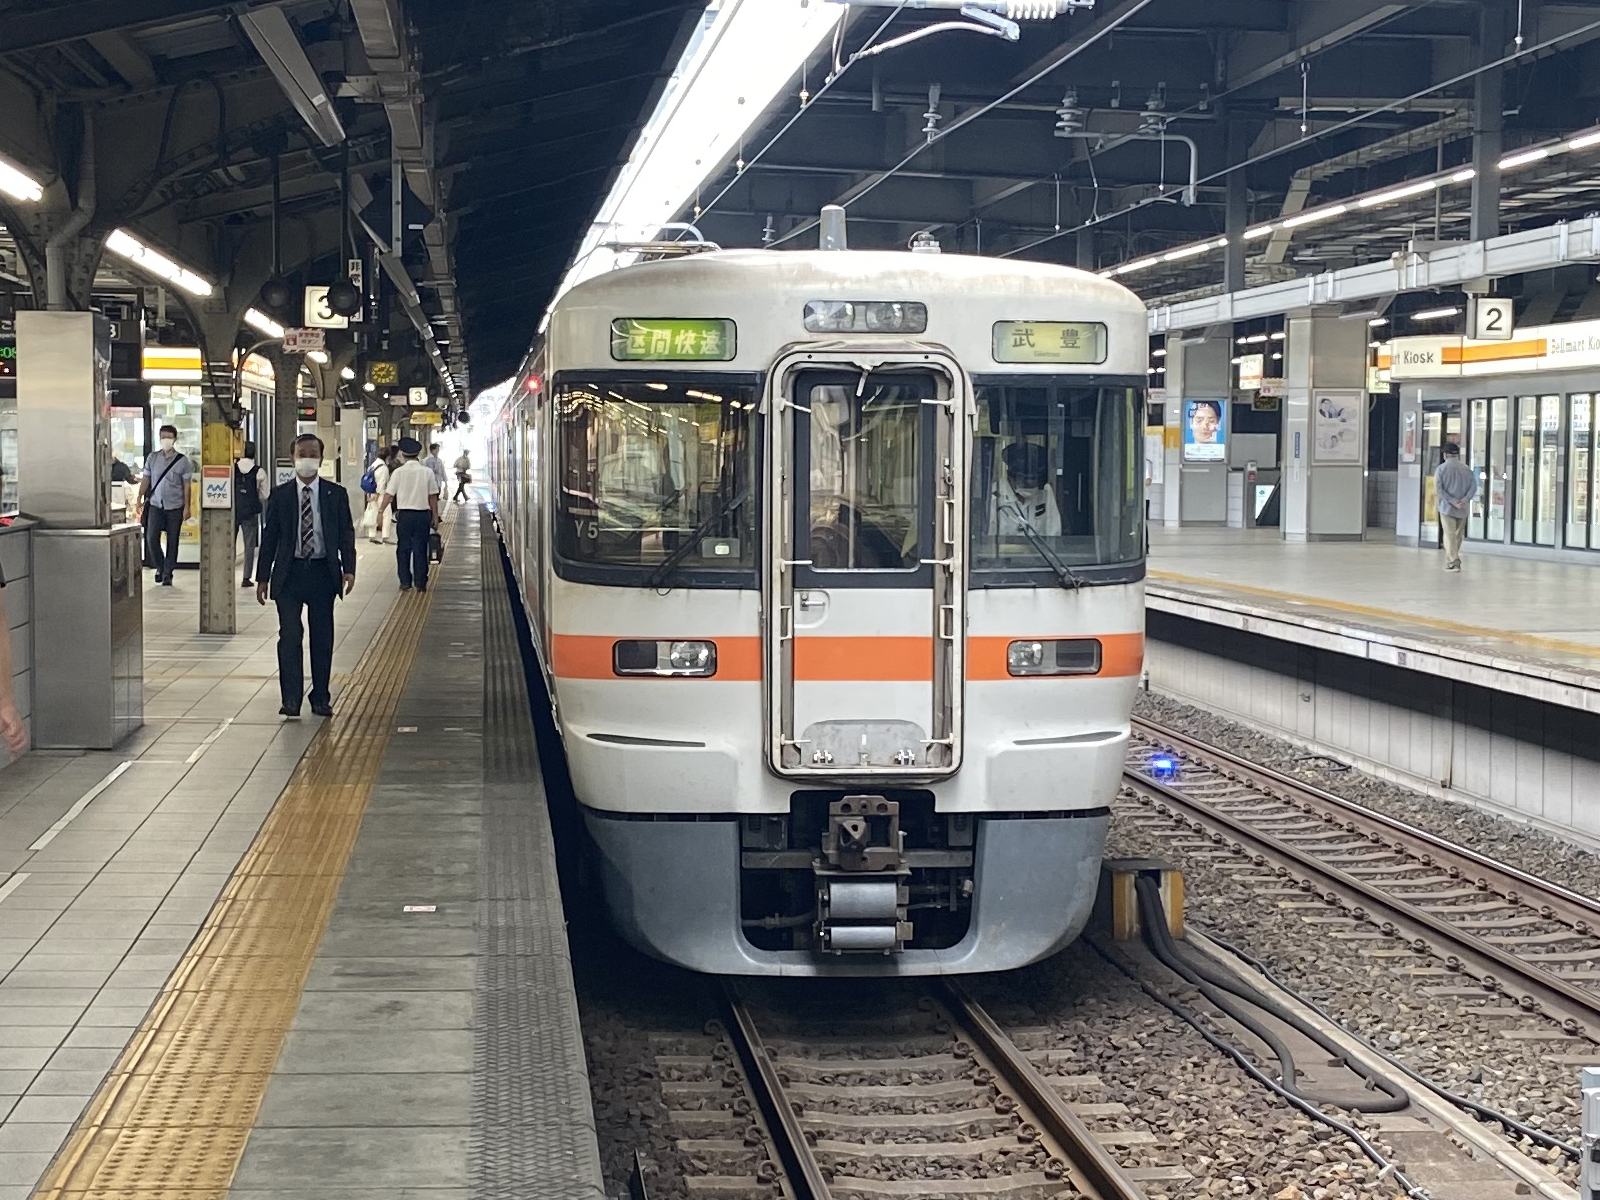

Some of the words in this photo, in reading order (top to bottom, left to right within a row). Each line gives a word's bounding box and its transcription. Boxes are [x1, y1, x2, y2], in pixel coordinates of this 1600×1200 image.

[317, 295, 336, 319] 3
[1485, 307, 1503, 331] 2
[626, 328, 721, 354] 区間快速
[1403, 350, 1434, 364] Kiosk
[414, 391, 423, 402] 3
